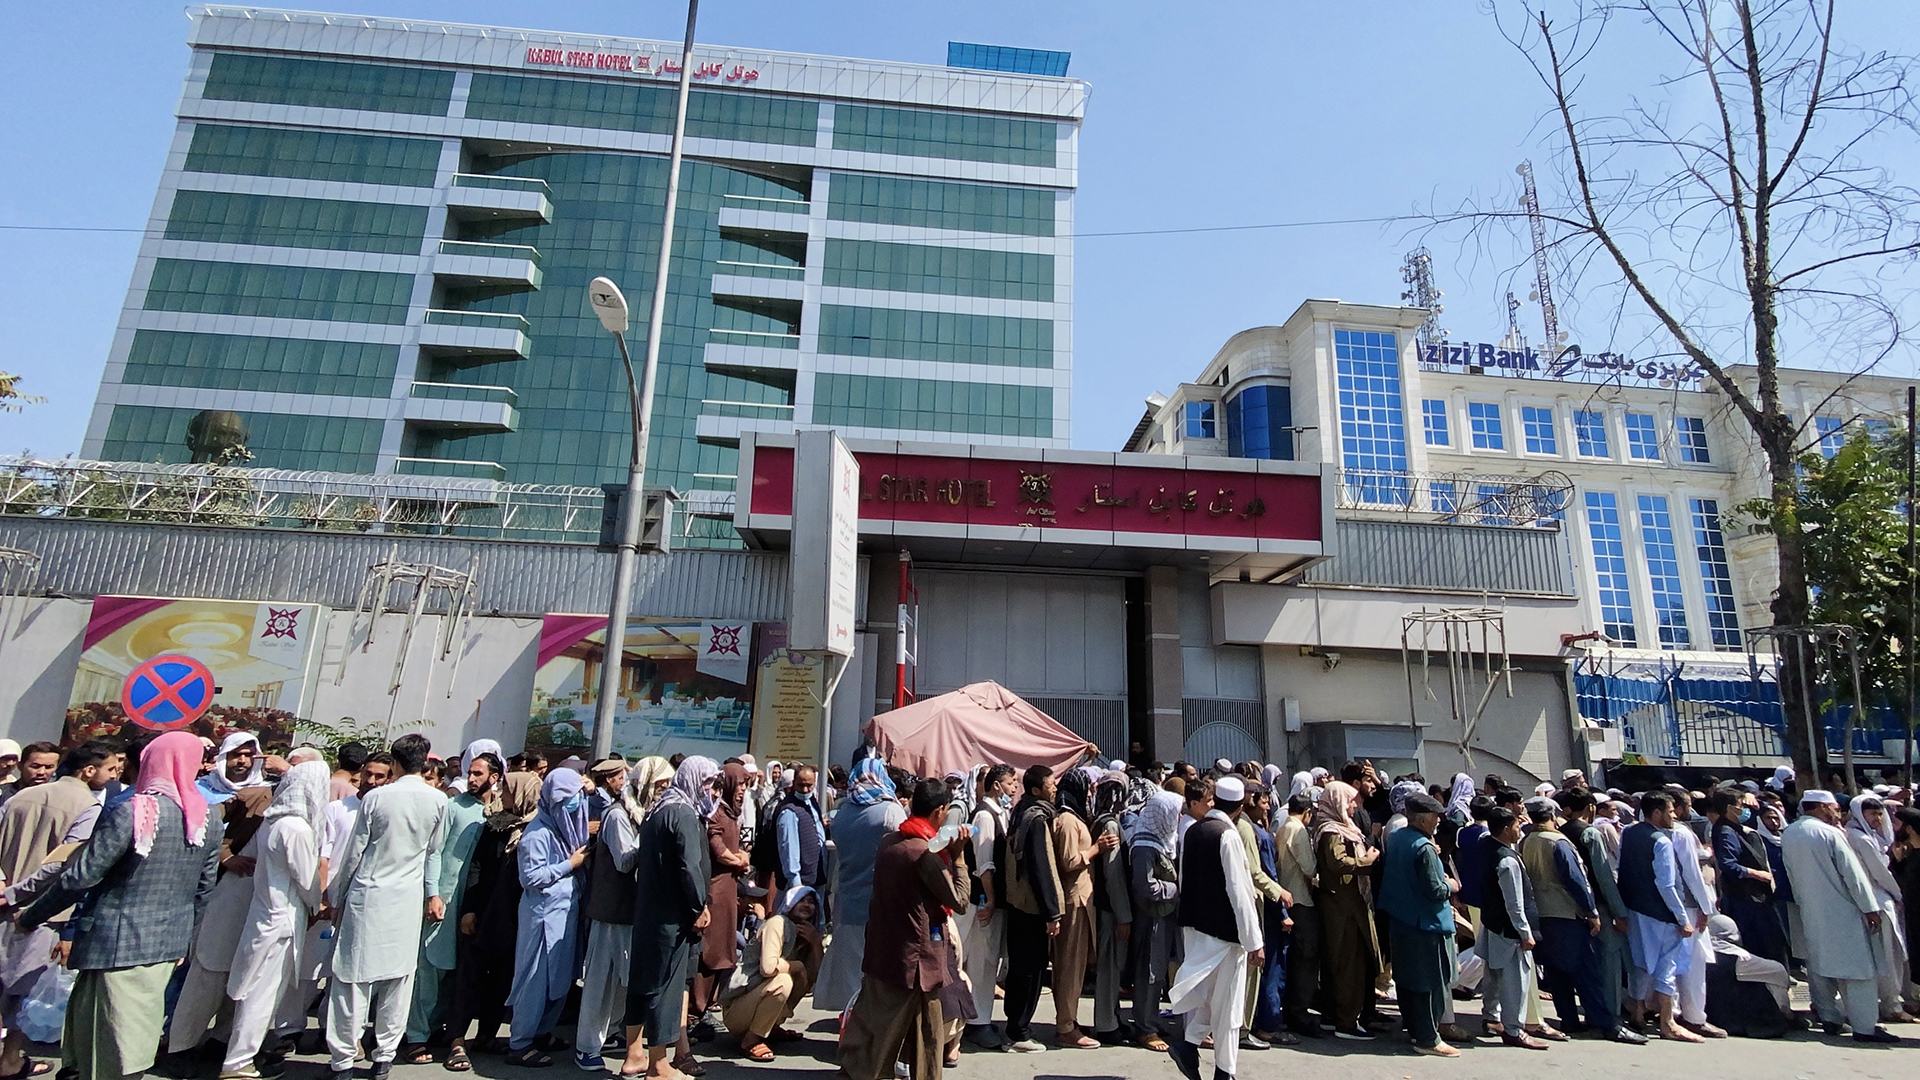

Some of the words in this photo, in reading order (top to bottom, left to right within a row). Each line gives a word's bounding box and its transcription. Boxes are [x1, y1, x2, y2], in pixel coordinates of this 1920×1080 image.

[527, 48, 564, 66] KABUL
[567, 51, 595, 68] STAR
[597, 54, 633, 71] HOTEL
[655, 59, 683, 76] ستار
[693, 62, 722, 79] کابل
[726, 65, 760, 84] هوتل
[1479, 342, 1540, 371] Bank
[1584, 351, 1635, 376] بانک
[880, 474, 929, 502] STAR
[936, 477, 997, 507] HOTEL
